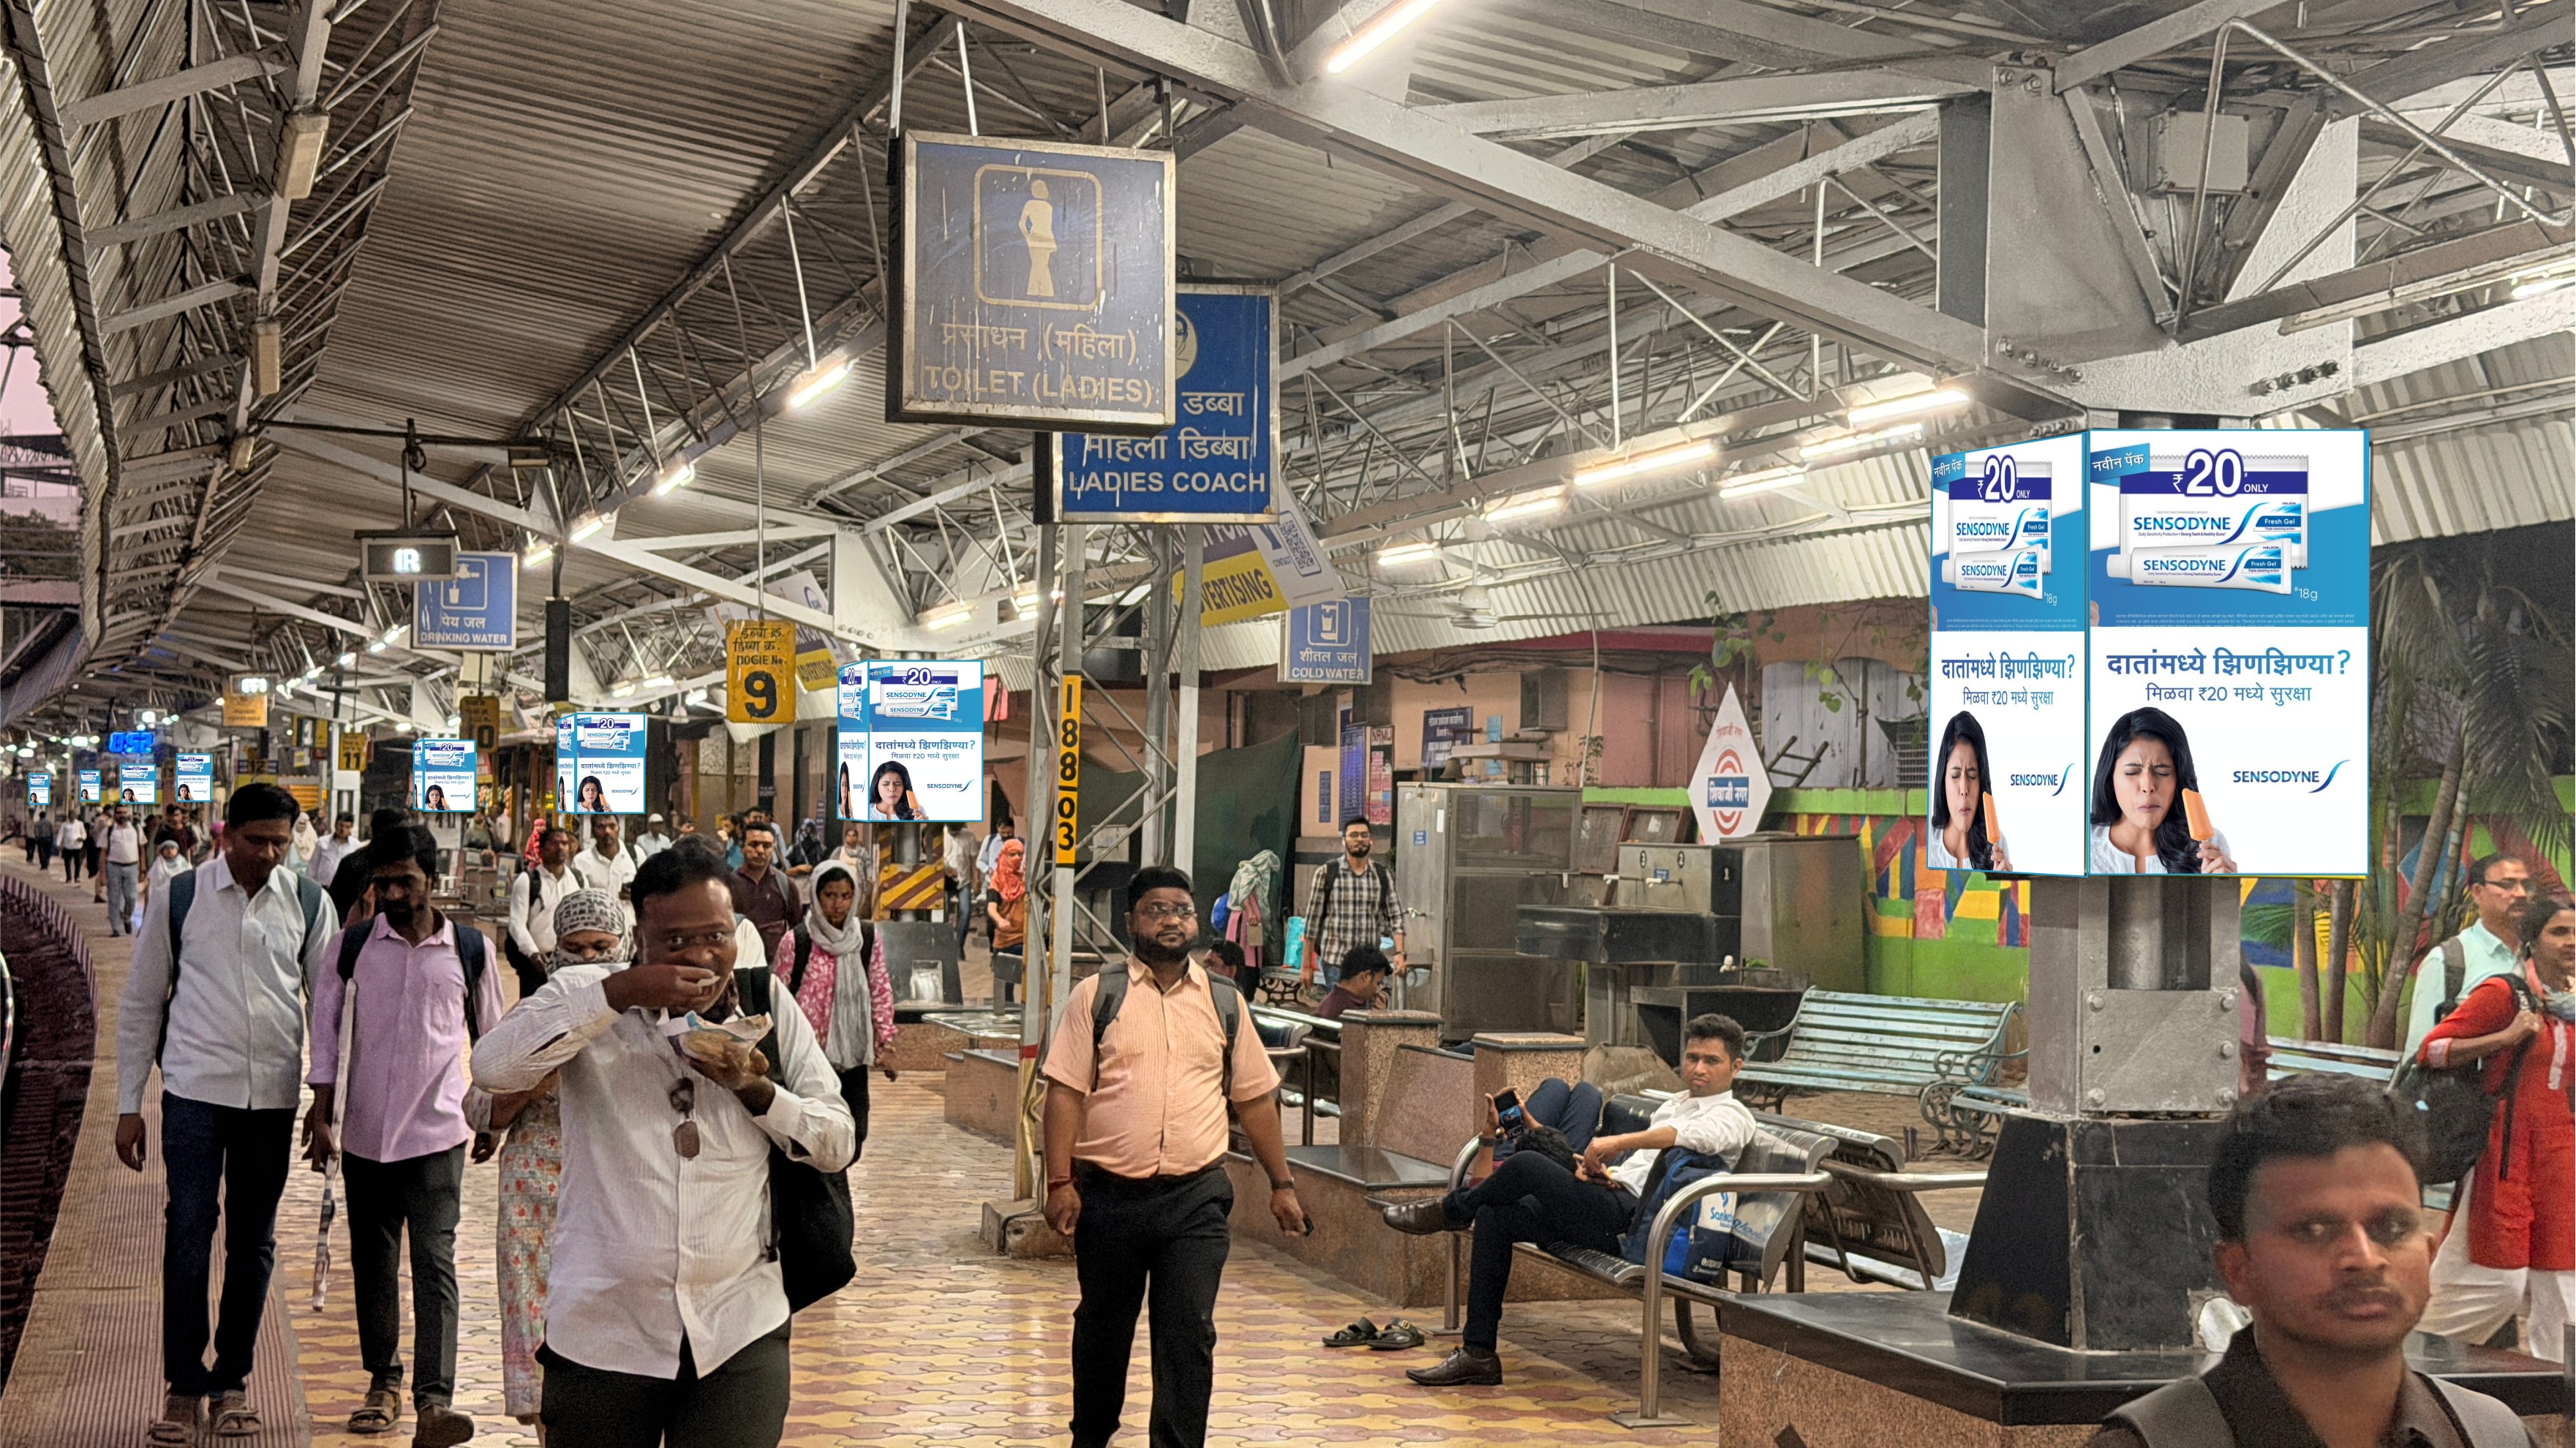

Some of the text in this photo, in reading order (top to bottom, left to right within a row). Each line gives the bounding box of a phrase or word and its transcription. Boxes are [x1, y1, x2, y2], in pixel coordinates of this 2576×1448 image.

[941, 323, 1137, 366] प्रसाधन (महिला)
[924, 366, 1152, 408] TOILET (LADIES)
[1181, 392, 1245, 415] डब्बा
[1178, 427, 1250, 460] डिब्बा
[1934, 462, 1951, 478] नवीन
[2092, 452, 2144, 472] नवीन पॅक
[1069, 472, 1265, 492] LADIES COACH
[2243, 483, 2269, 493] ONLY
[2016, 489, 2030, 499] ONLY
[1956, 522, 2010, 536] SENSODYNE
[2134, 516, 2232, 531] SENSODYNE
[1962, 565, 2007, 576] SENSODYNE
[2143, 559, 2226, 571] SENSODYNE
[442, 612, 486, 630] पेय जल
[421, 633, 507, 644] DRINKING WATER
[771, 655, 787, 665] No.
[1300, 647, 1357, 665] शीतल जल
[2106, 647, 2207, 675] दातांमध्ये
[1292, 667, 1364, 679] COLD WATER
[1941, 652, 1997, 679] दातांमध्ये
[745, 670, 777, 719] 9
[1962, 686, 2055, 711] मिळवा ₹20 मध्ये सुरक्षा
[2145, 682, 2313, 706] मिळवा ₹20 मध्ये सुरक्षा
[1371, 728, 1392, 742] NRMU
[875, 739, 916, 750] दातांमध्ये
[344, 752, 361, 769] 11
[2010, 774, 2058, 787] SENSODYNE
[2233, 770, 2320, 783] SENSODYNE
